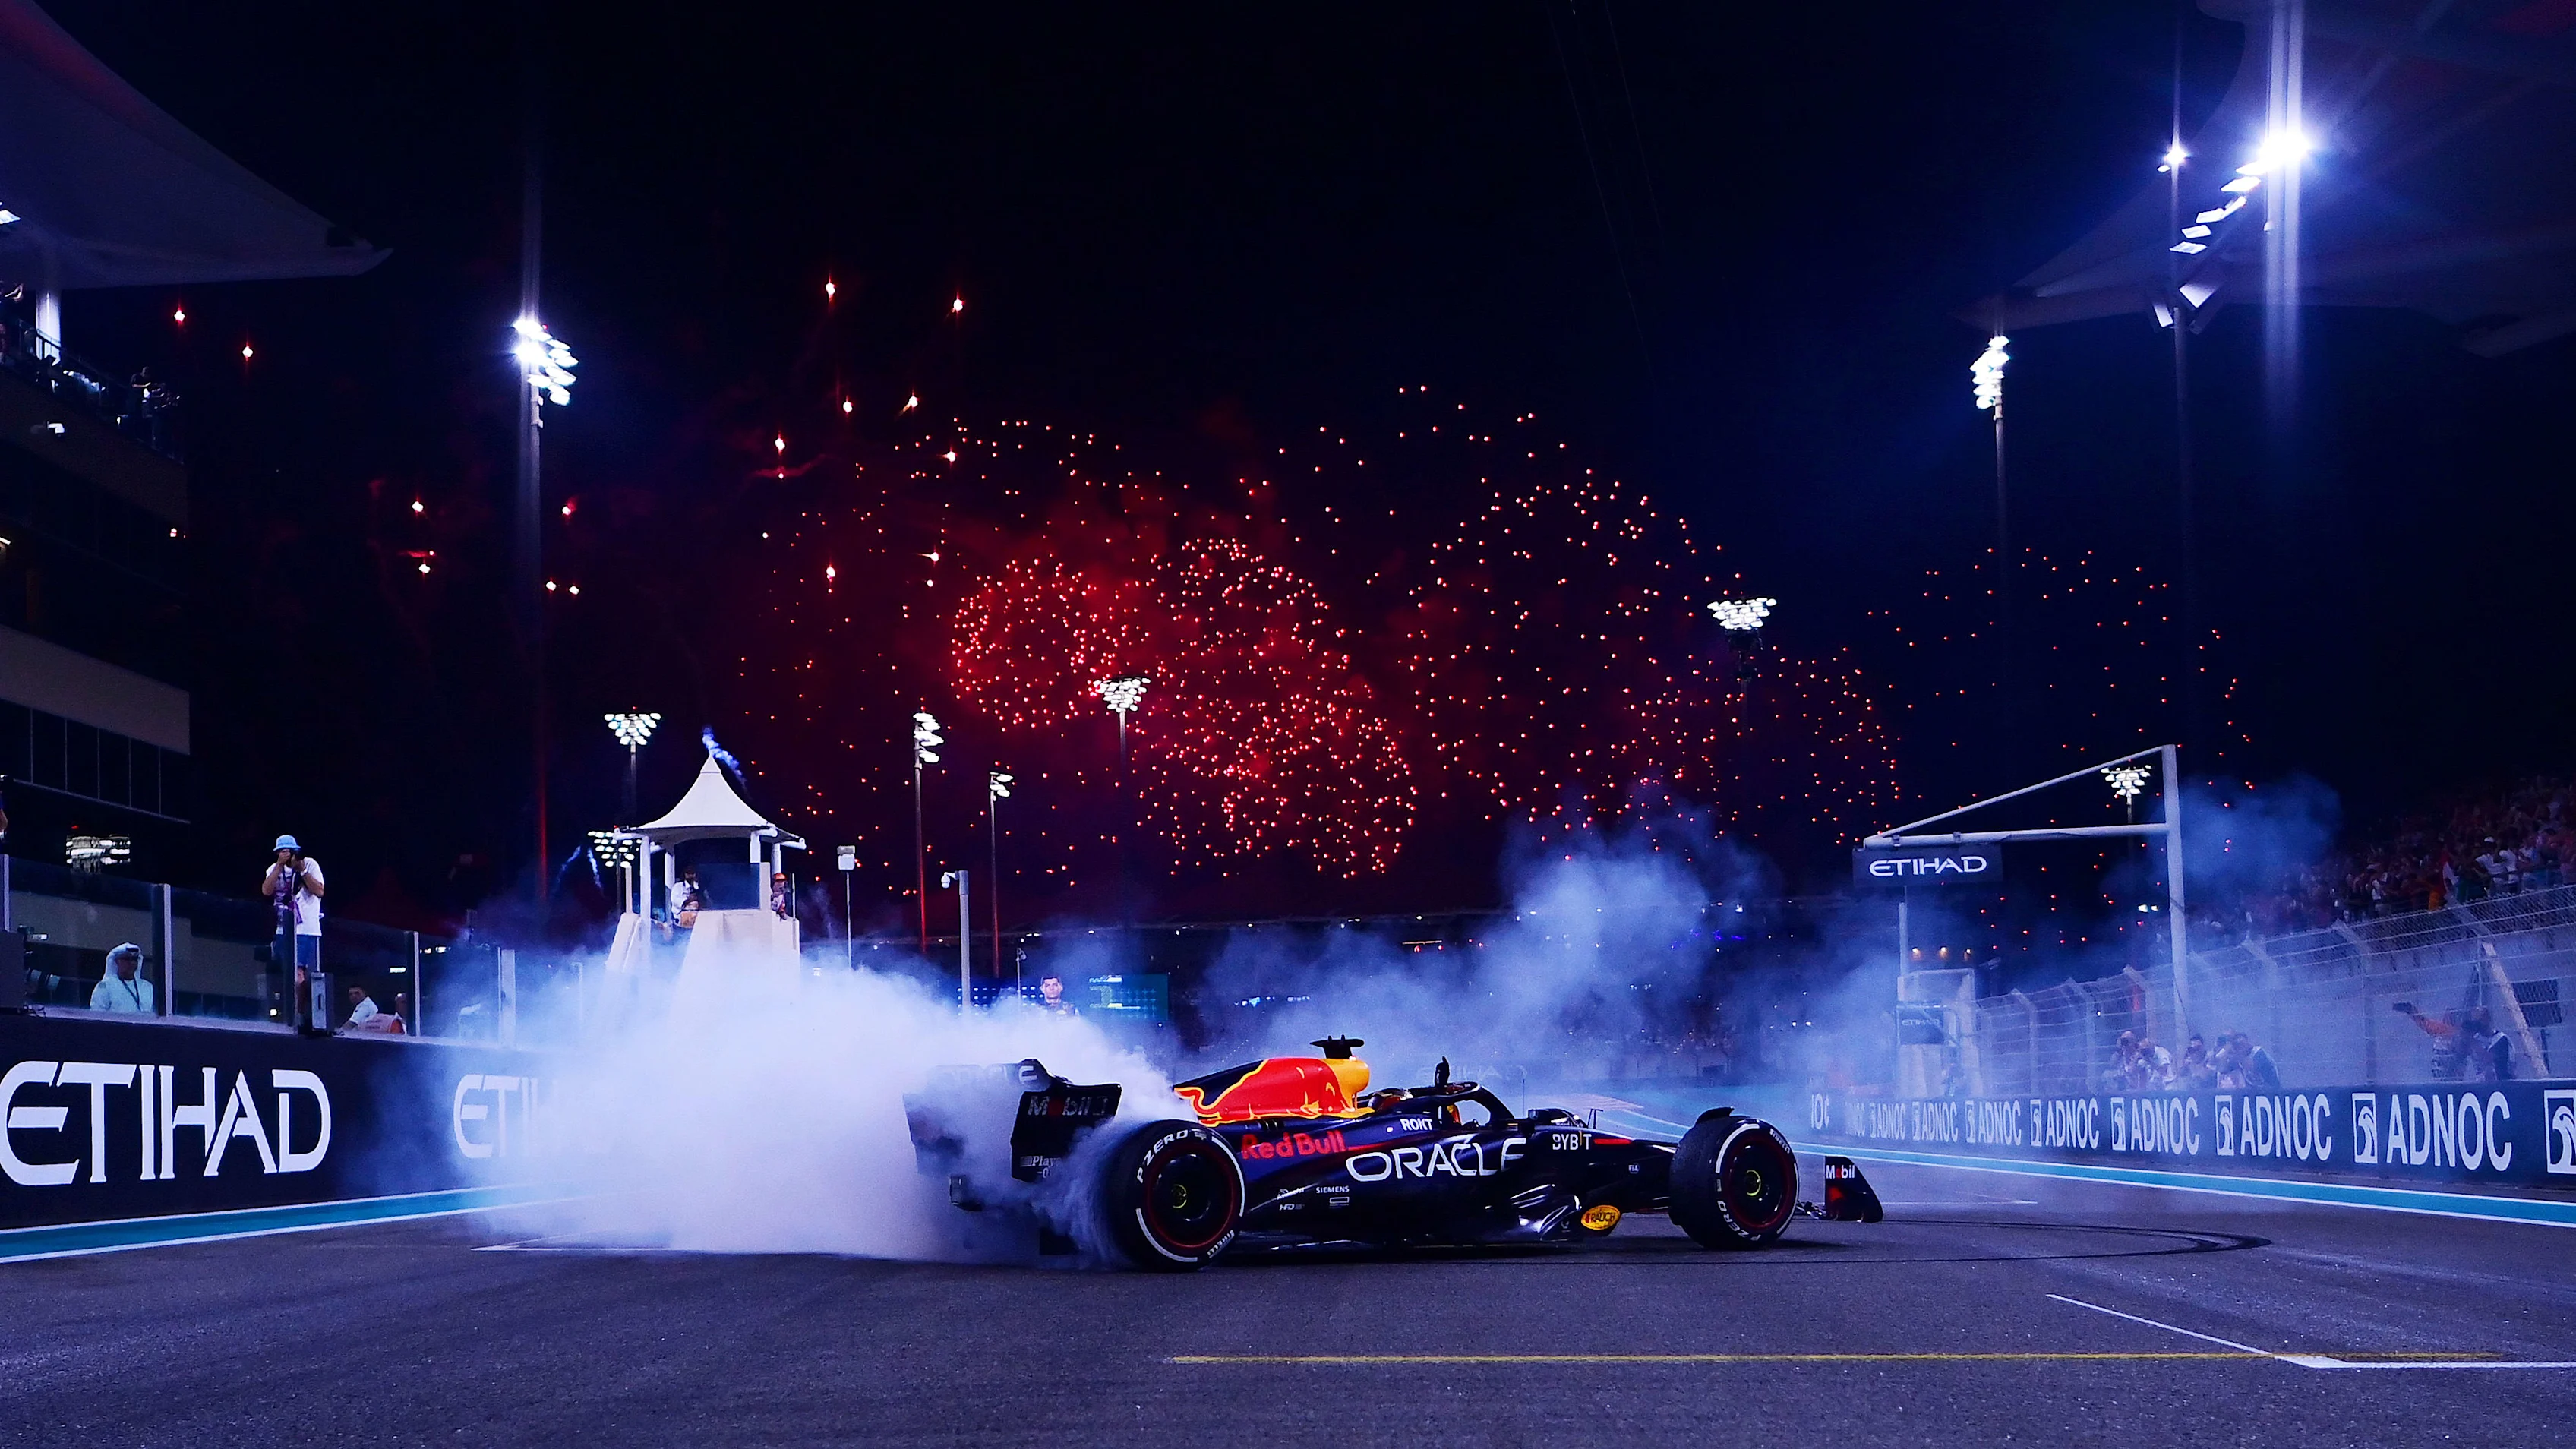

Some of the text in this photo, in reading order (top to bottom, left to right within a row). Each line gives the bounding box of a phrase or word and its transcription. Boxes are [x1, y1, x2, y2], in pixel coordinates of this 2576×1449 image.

[1869, 856, 1987, 876] ETIHAD
[1028, 1096, 1091, 1116] Mobil
[0, 1060, 331, 1185] ETIHAD
[1400, 1118, 1433, 1131] ROKT
[1877, 1102, 1906, 1139] ADNOC
[1922, 1101, 1959, 1142] ADNOC
[1978, 1100, 2022, 1146] ADNOC
[2045, 1097, 2100, 1149] ADNOC
[2131, 1097, 2199, 1155] ADNOC
[2240, 1093, 2331, 1160] ADNOC
[2386, 1091, 2512, 1172] ADNOC
[1241, 1129, 1347, 1160] Red Bull
[1552, 1130, 1592, 1150] BYBIT
[1136, 1129, 1189, 1183] P ZERO
[1346, 1137, 1526, 1182] ORACLE
[1826, 1163, 1855, 1179] Mobil
[1315, 1185, 1350, 1194] SIEMENS
[1717, 1200, 1749, 1238] ZERO
